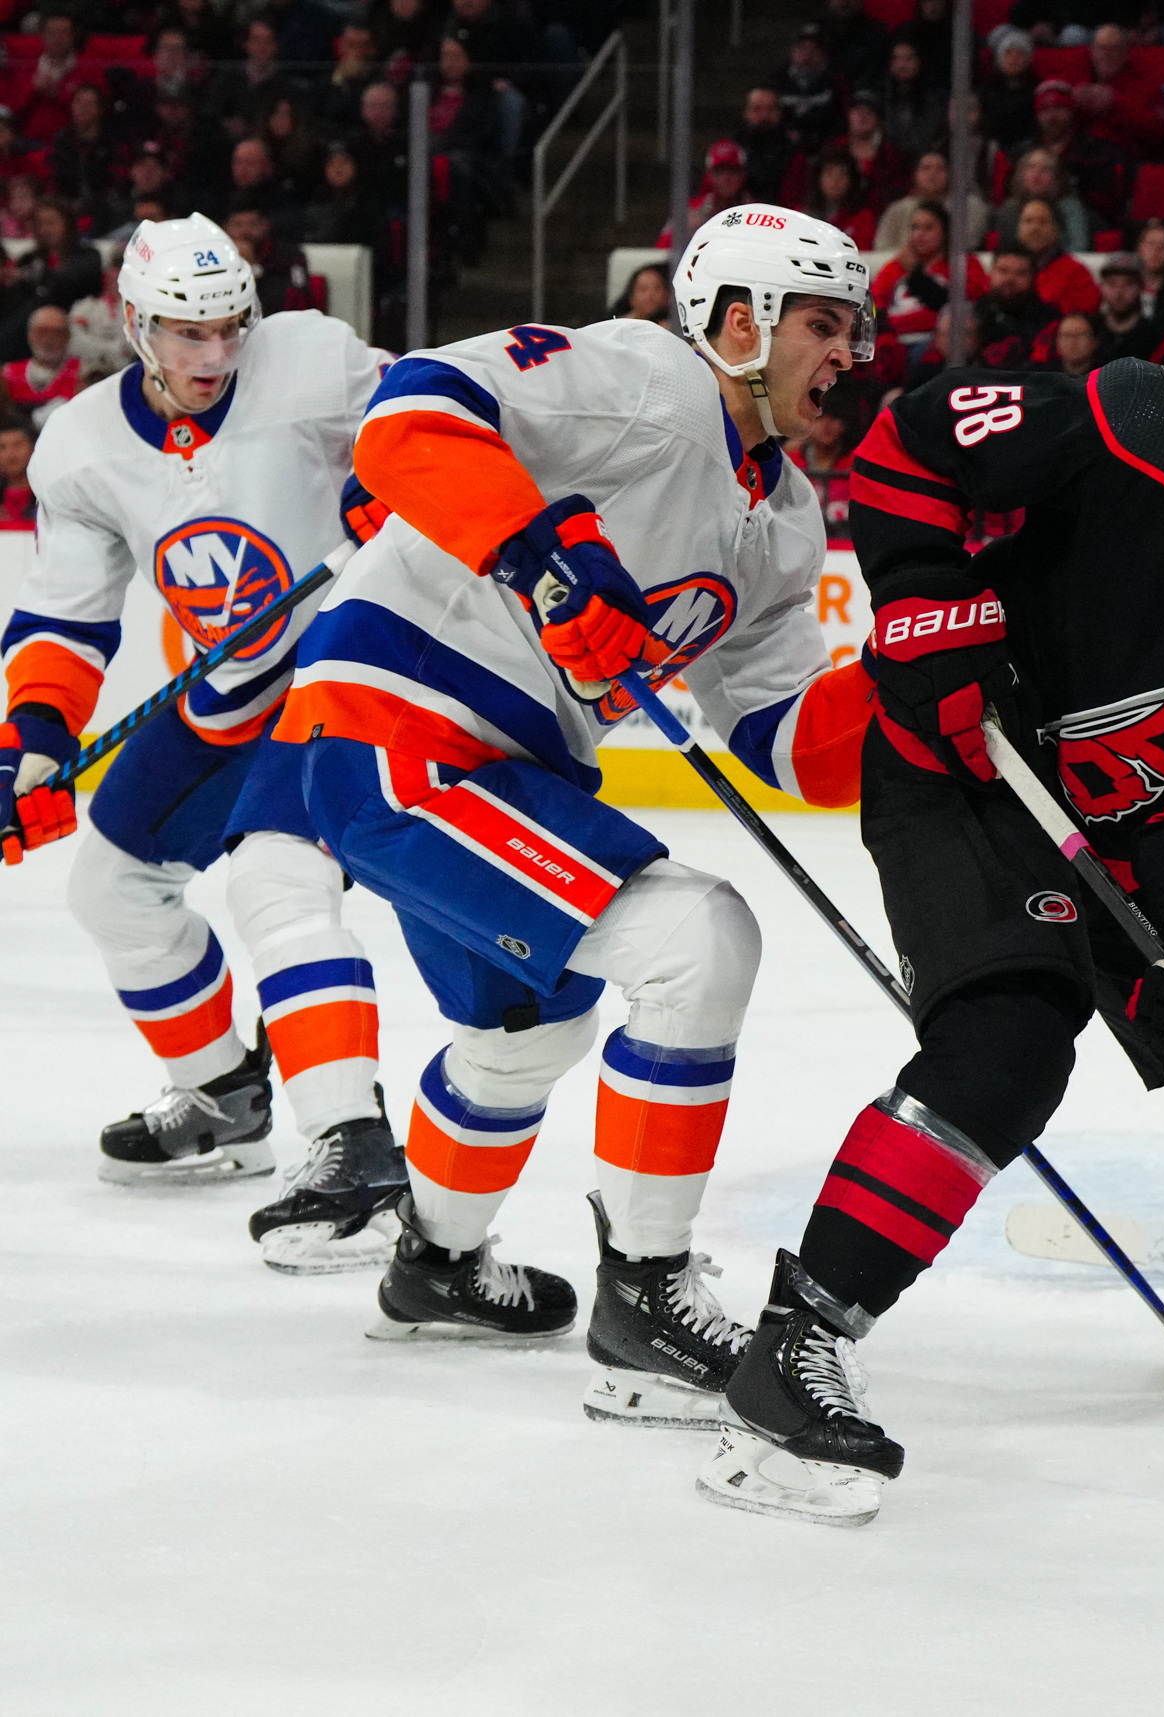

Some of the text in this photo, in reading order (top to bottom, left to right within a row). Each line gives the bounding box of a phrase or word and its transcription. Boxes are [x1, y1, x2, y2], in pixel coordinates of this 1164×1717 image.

[745, 212, 787, 230] UBS
[135, 237, 154, 263] UBS
[193, 250, 220, 267] 24
[200, 289, 233, 300] CCM
[948, 385, 1024, 448] 58
[1128, 901, 1158, 936] BUNTING
